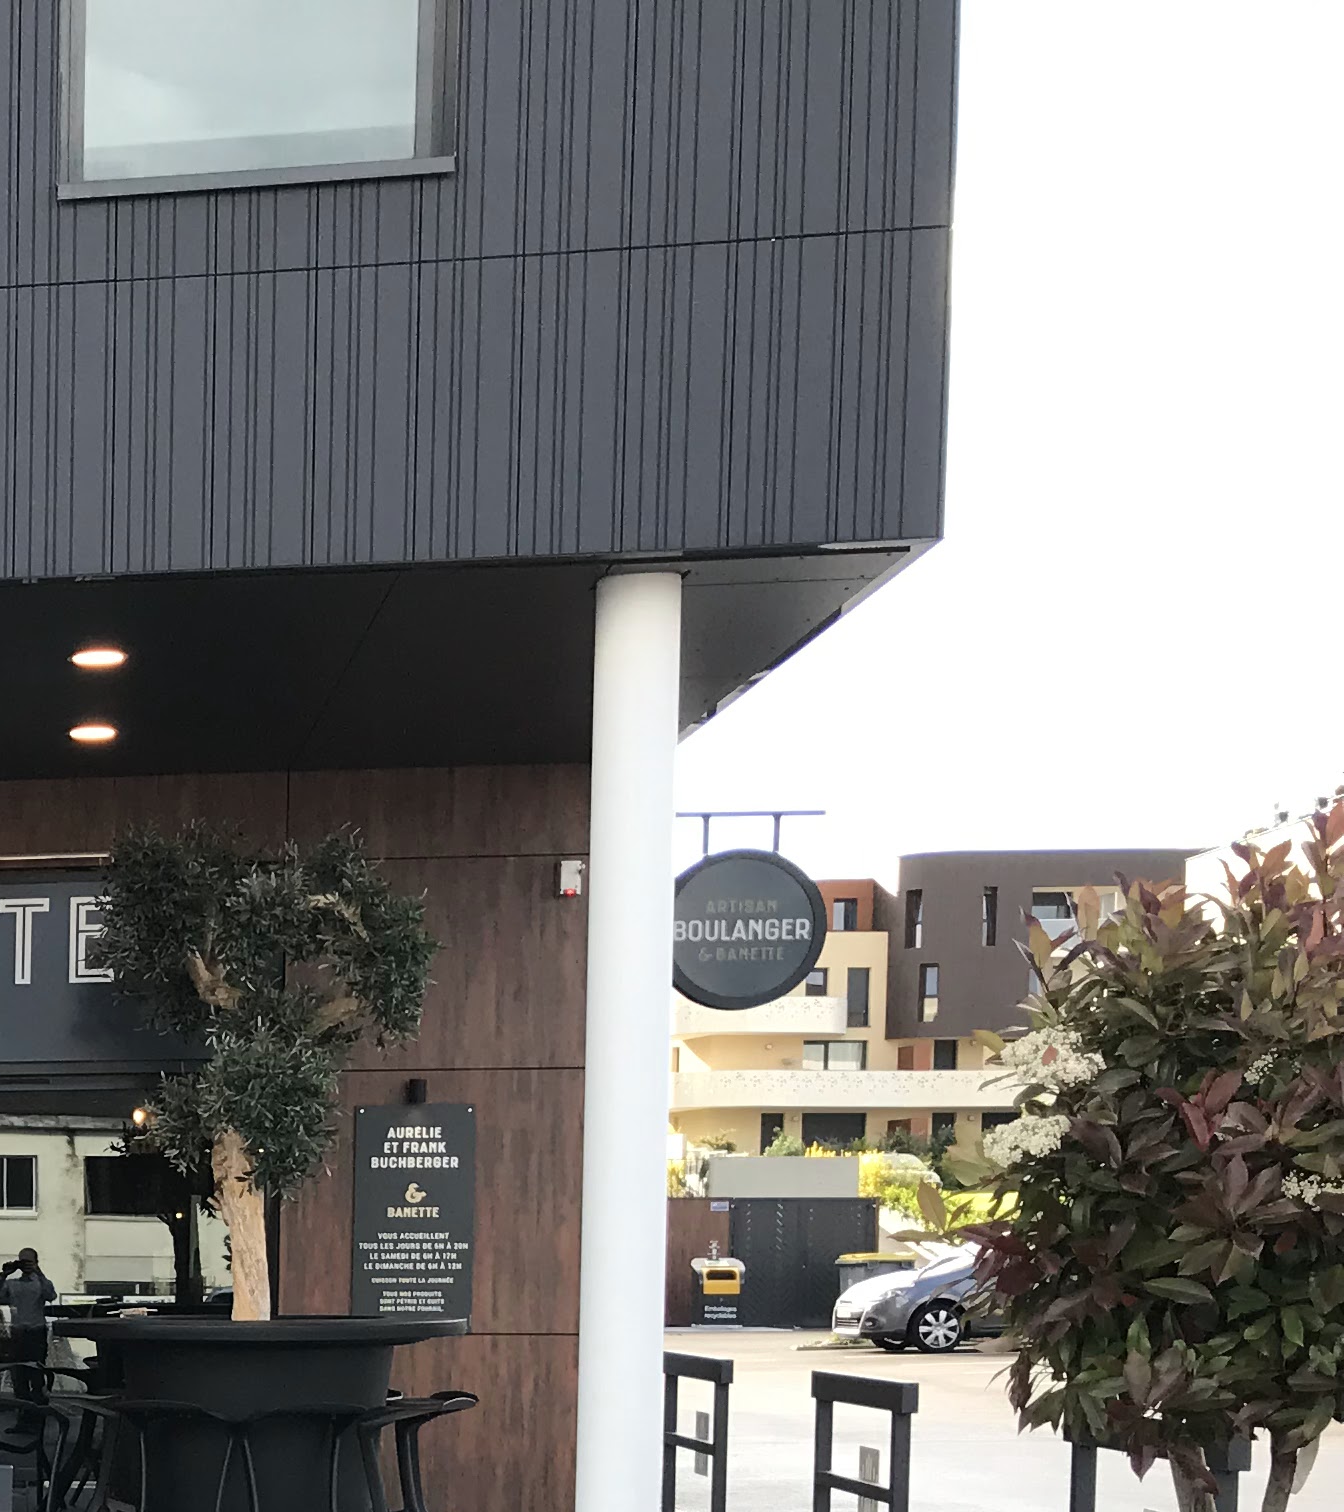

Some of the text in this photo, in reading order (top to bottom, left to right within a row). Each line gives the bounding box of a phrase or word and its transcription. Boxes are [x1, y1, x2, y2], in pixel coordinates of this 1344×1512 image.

[705, 899, 778, 914] ARTISAN
[674, 918, 812, 942] BOULANGER
[698, 947, 784, 962] & BANETTE
[384, 1142, 446, 1153] ET FRANK
[370, 1156, 459, 1168] BUCHBERGER
[404, 1182, 427, 1204] &
[386, 1207, 440, 1218] BANETTE
[377, 1232, 450, 1240] VOUS ACCUEILLENT
